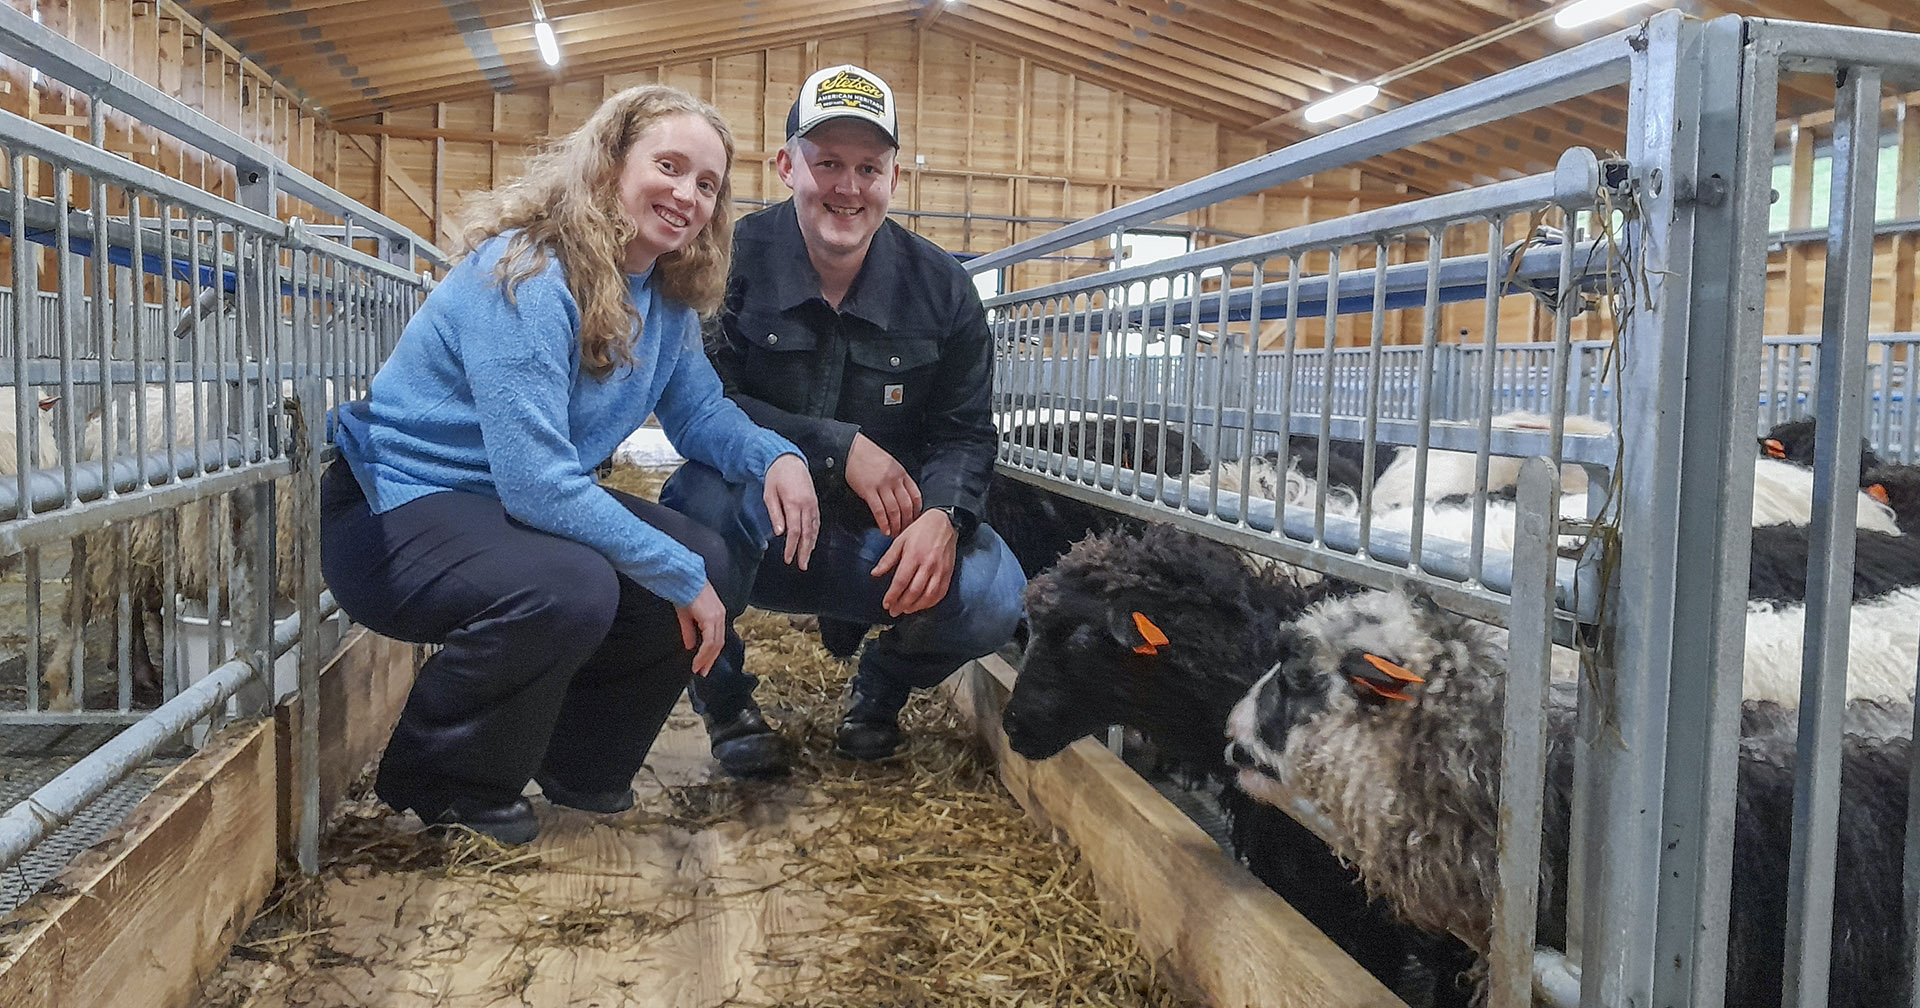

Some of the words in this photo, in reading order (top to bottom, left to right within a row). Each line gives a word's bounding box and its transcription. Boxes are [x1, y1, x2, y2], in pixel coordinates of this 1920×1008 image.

[818, 71, 884, 98] Stetson
[817, 93, 853, 101] AMERICAN
[855, 94, 884, 110] HERITAGE
